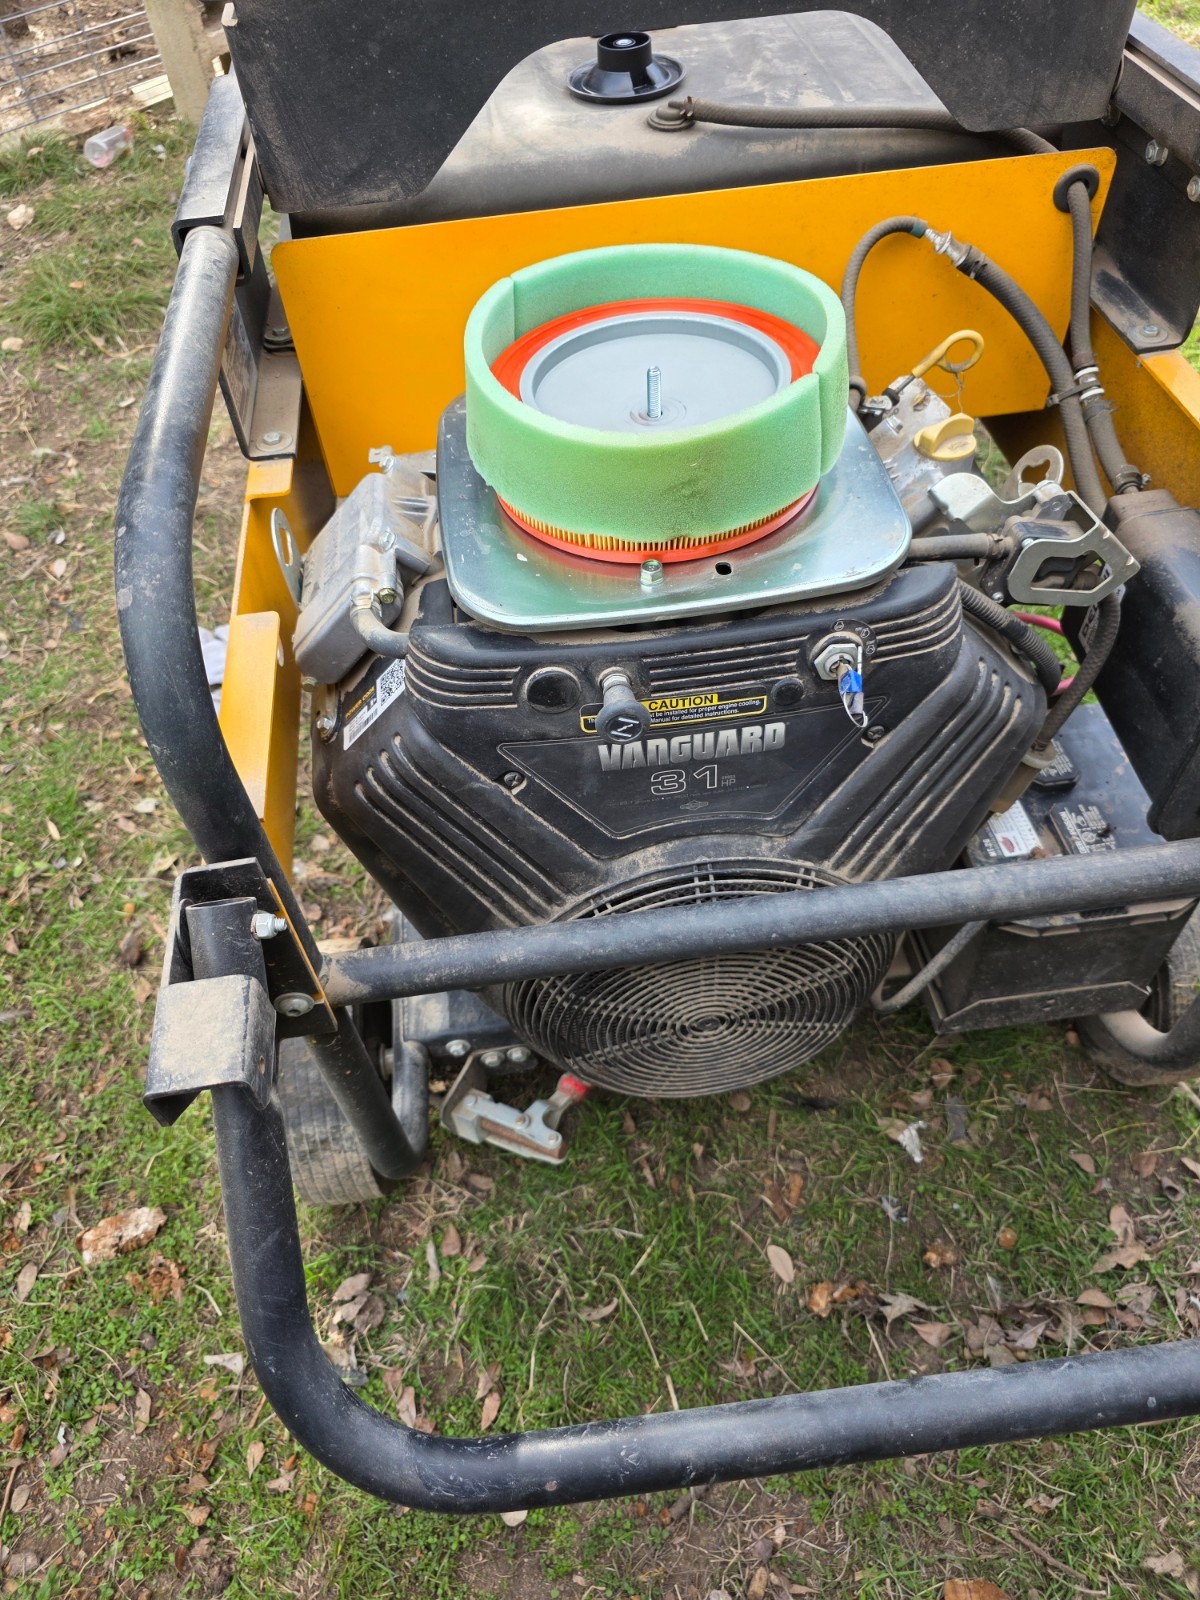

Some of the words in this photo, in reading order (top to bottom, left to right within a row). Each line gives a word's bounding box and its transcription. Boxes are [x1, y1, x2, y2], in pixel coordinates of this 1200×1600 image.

[648, 694, 714, 711] CAUTION
[664, 708, 688, 716] installed
[698, 704, 717, 713] proper
[718, 702, 738, 710] engine
[650, 715, 671, 723] Manual
[681, 711, 704, 720] detailed
[704, 708, 740, 717] instructions.
[598, 721, 787, 771] VANGUARD
[651, 764, 718, 795] 31
[721, 778, 736, 787] HP
